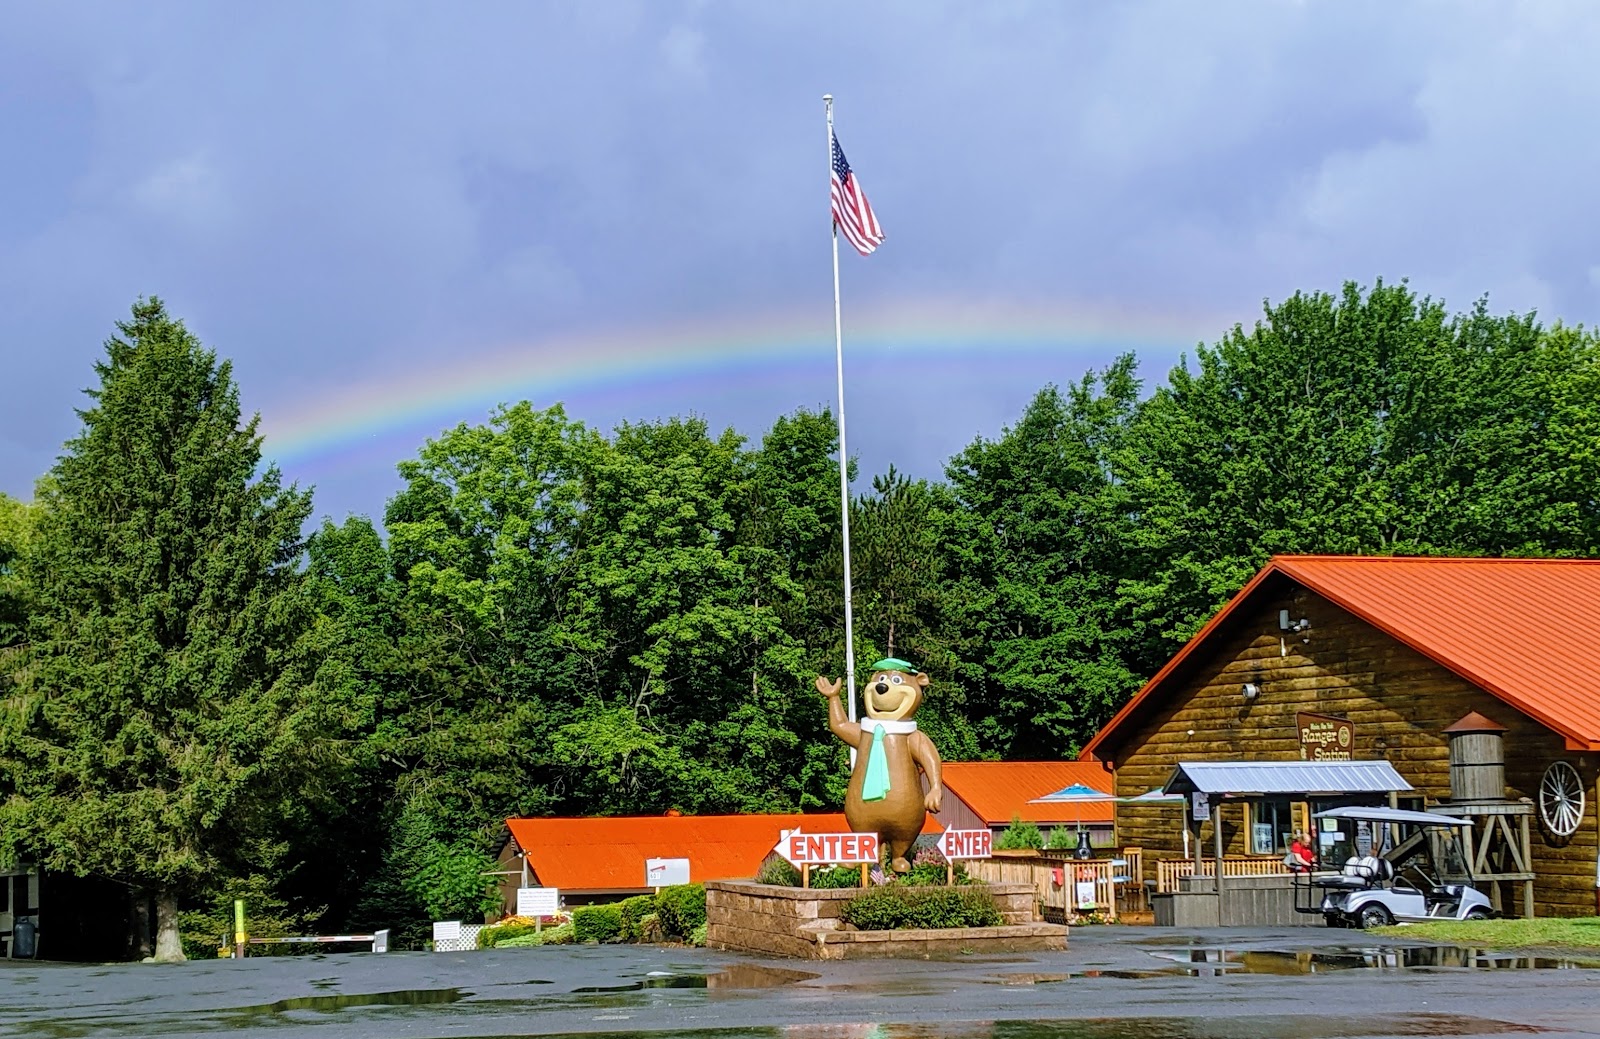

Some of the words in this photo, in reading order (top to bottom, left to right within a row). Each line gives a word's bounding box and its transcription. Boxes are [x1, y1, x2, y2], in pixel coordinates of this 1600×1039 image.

[1301, 728, 1337, 747] Ranger
[1314, 746, 1350, 761] Station
[790, 835, 877, 861] ENTER
[945, 831, 991, 857] ENTER
